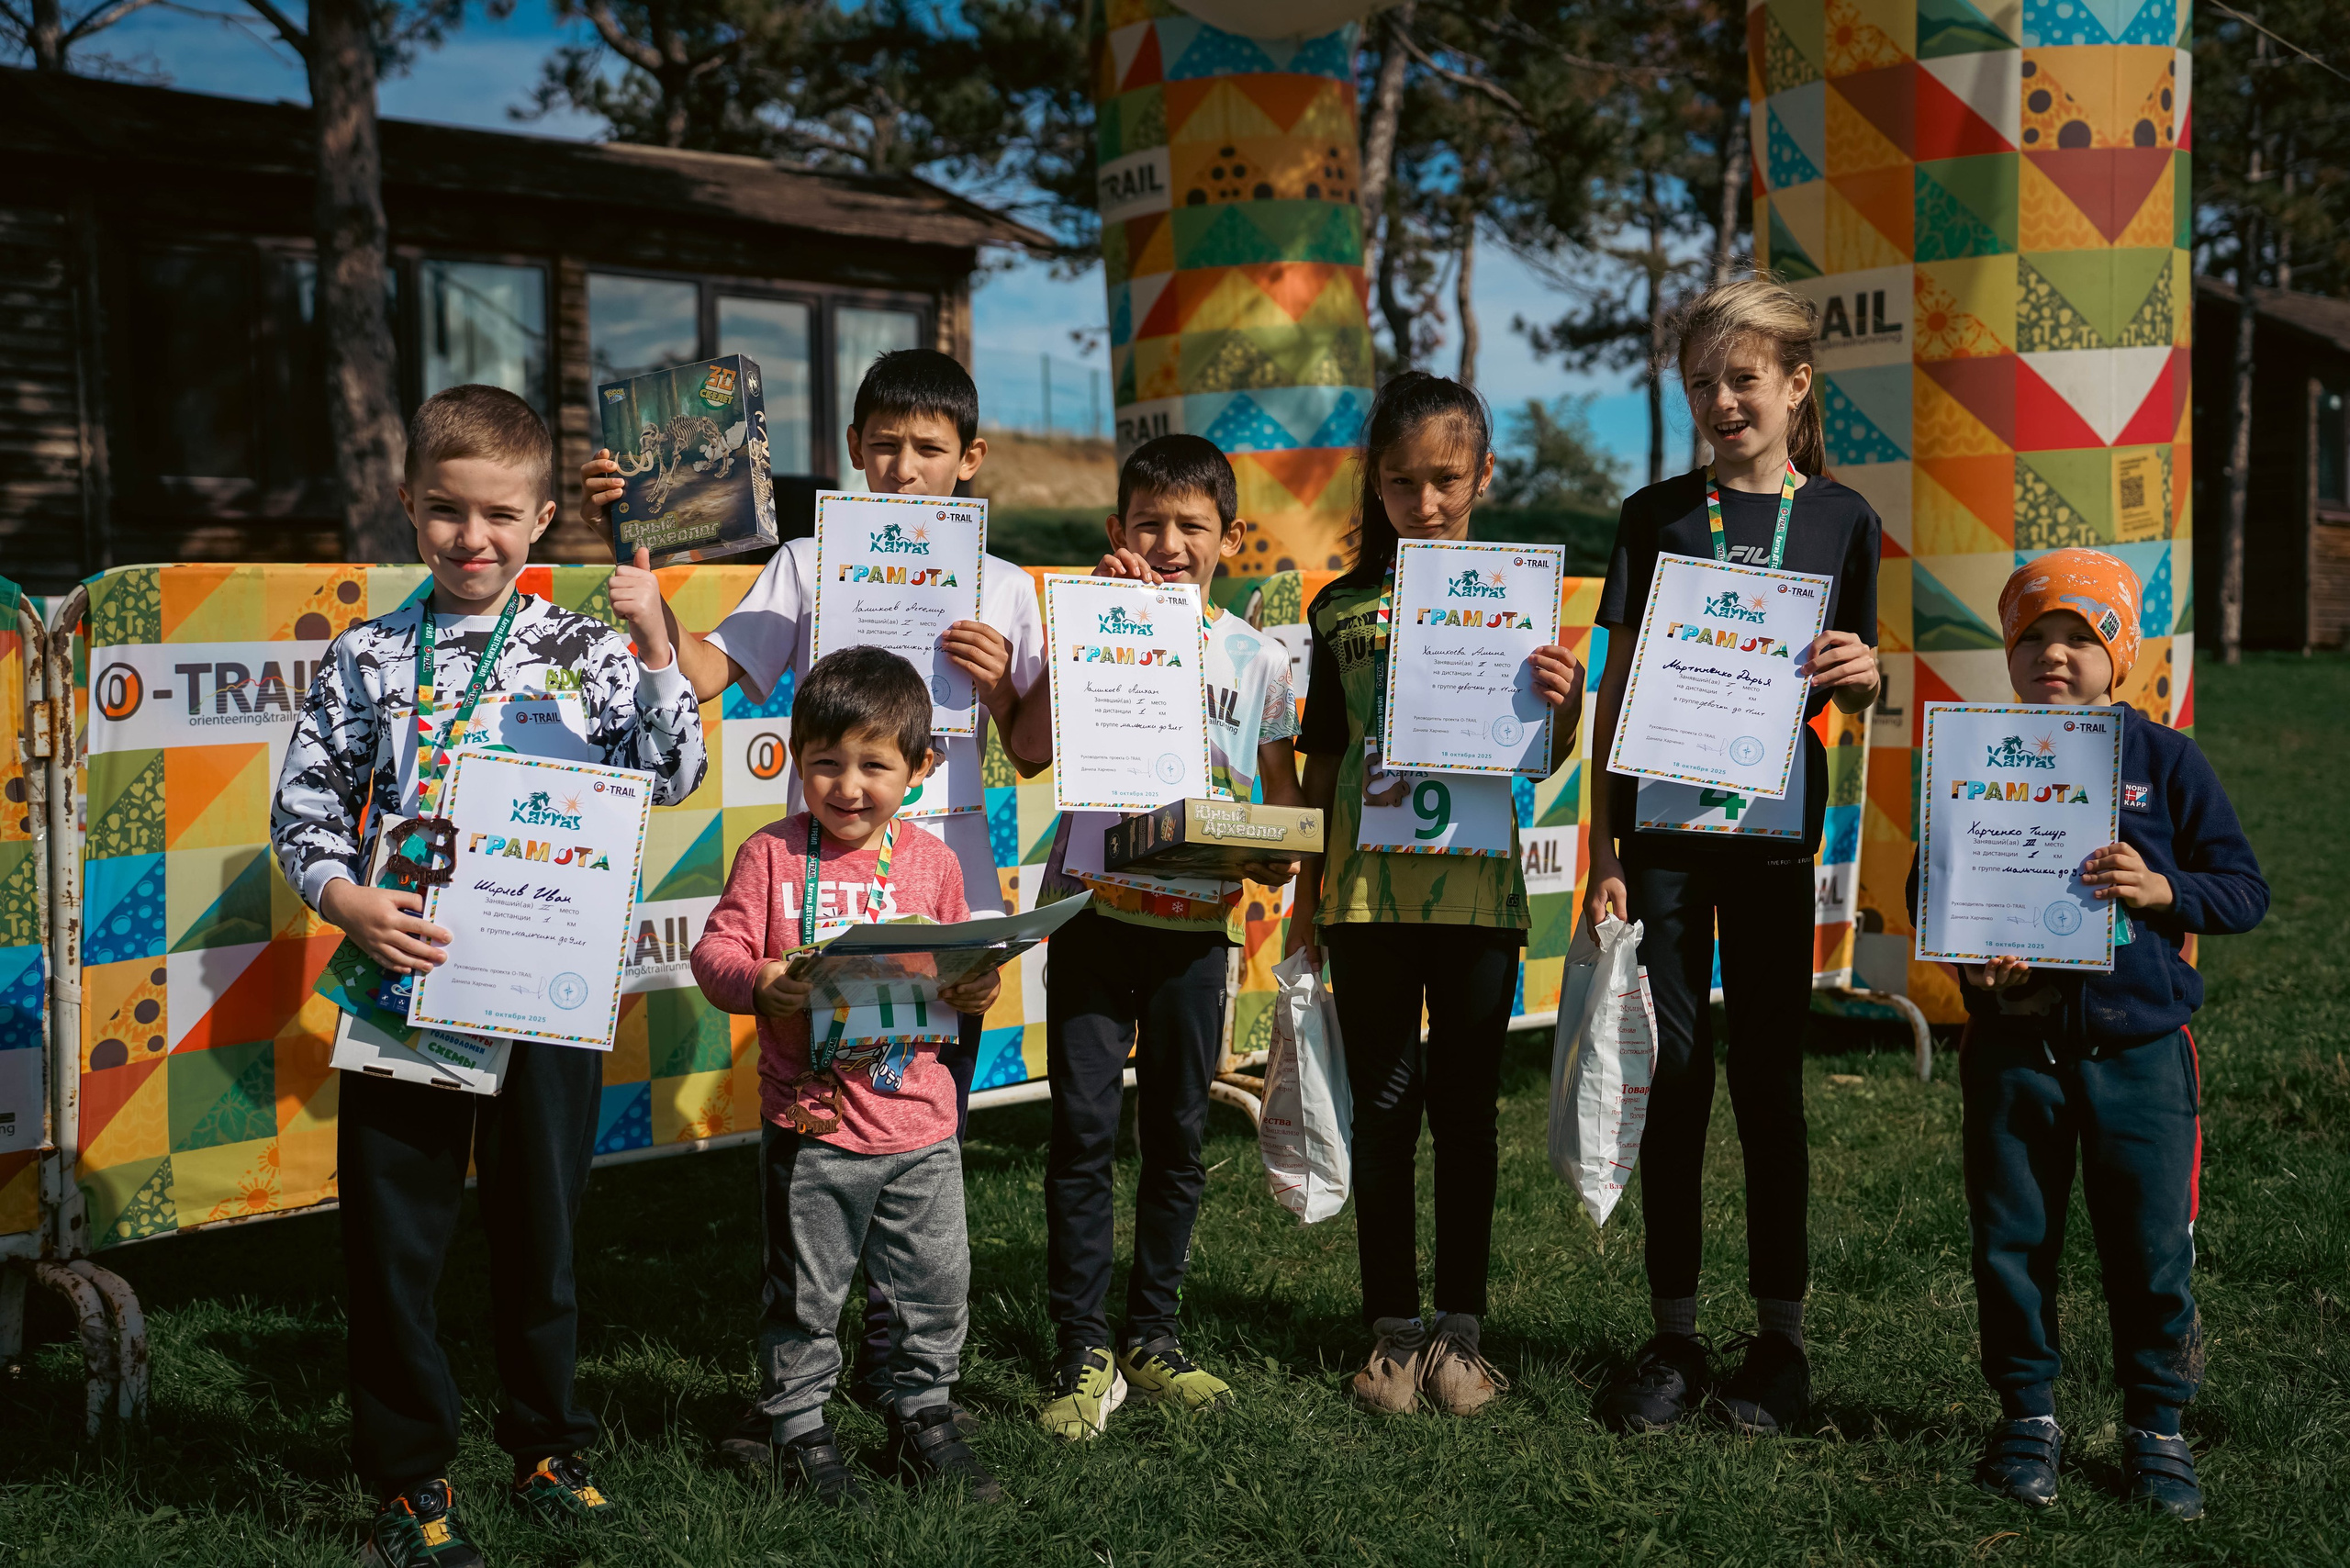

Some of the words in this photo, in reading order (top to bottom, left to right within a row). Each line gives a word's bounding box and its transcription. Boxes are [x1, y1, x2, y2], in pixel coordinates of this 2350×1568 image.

[1820, 289, 1903, 341] AIL
[699, 389, 734, 405] СКЕЛЕТ
[869, 532, 930, 554] Karras
[1728, 545, 1783, 565] FIL
[1771, 554, 1780, 569] ДЕТС
[839, 564, 957, 587] ГРАМОТА
[1448, 577, 1506, 599] Karras
[1416, 608, 1534, 630] ГРАМОТА
[1703, 596, 1768, 623] Karras
[858, 617, 899, 625] Занявший(ая)
[1098, 614, 1153, 636] Karras
[1665, 622, 1792, 657] ГРАМОТА
[1072, 644, 1181, 666] ГРАМОТА
[1433, 658, 1473, 666] Занявший(ая)
[545, 668, 583, 686] ADV
[1093, 696, 1131, 704] Занявший(ая)
[1986, 745, 2055, 768] Karras
[1683, 763, 1709, 773] октября
[1951, 780, 2089, 804] ГРАМОТА
[2125, 784, 2148, 792] NORD
[1195, 804, 1247, 823] Юный
[1412, 780, 1451, 840] 9
[2123, 800, 2146, 808] KAPP
[509, 799, 584, 831] Karras
[1203, 820, 1287, 837] Археолог
[1966, 821, 2021, 838] Харченко
[2030, 825, 2065, 841] Тимур
[1972, 837, 2020, 846] Занявший(ая)
[467, 832, 613, 871] ГРАМОТА
[1519, 840, 1562, 875] AIL
[484, 896, 534, 910] Занявший(ая)
[559, 907, 579, 915] место
[493, 911, 531, 923] дистанции
[486, 926, 510, 936] группе
[1995, 940, 2025, 949] октября
[494, 1010, 526, 1022] октября
[528, 1014, 546, 1023] 2025
[428, 1042, 476, 1070] СХЕМЫ
[1263, 1116, 1292, 1126] ества
